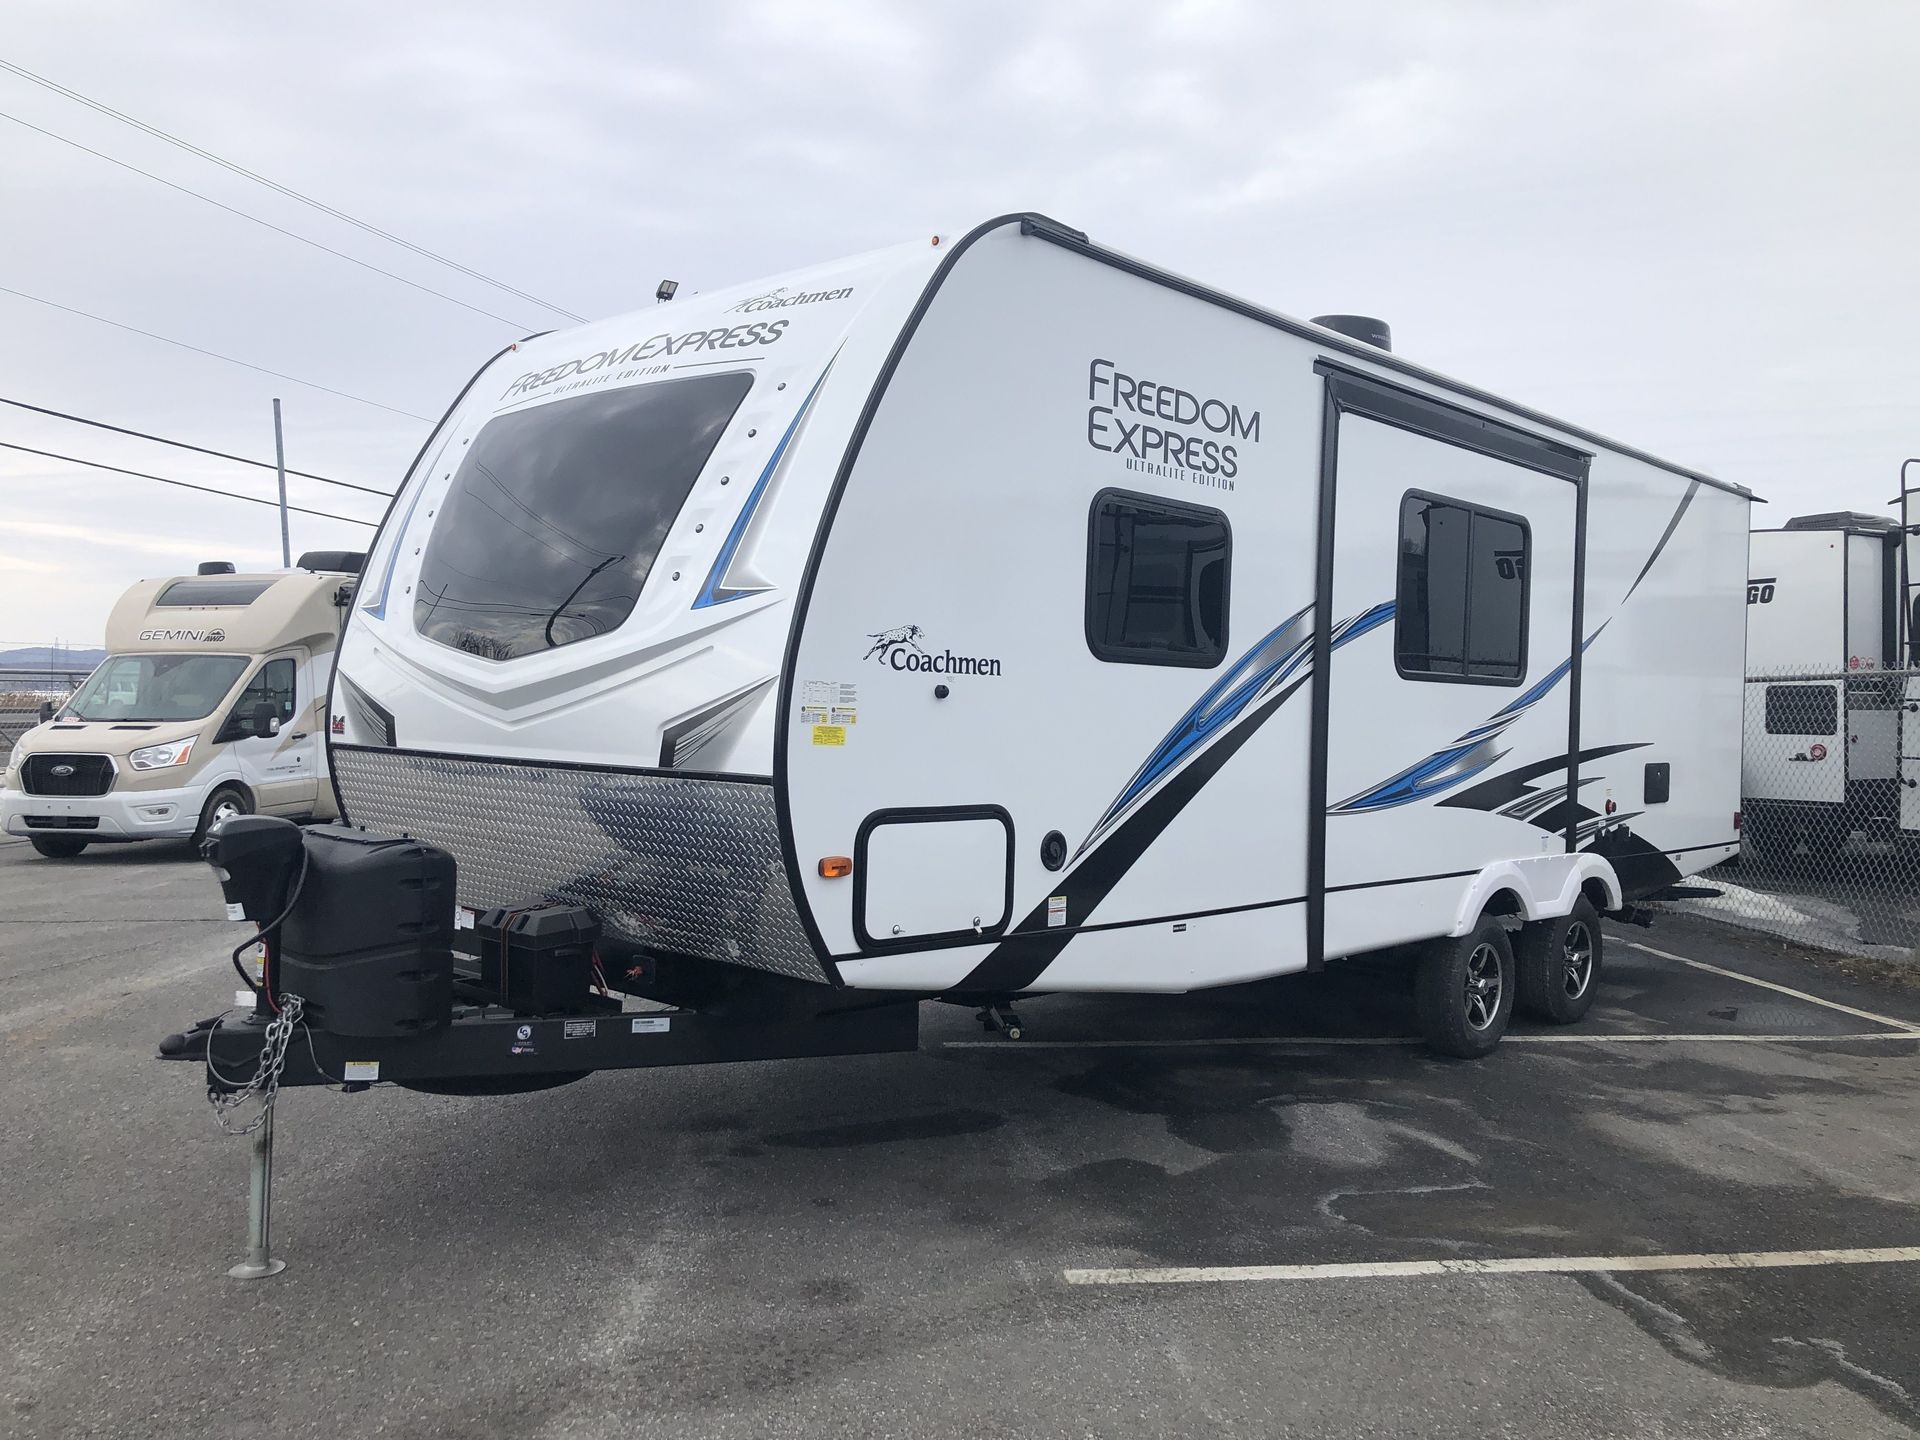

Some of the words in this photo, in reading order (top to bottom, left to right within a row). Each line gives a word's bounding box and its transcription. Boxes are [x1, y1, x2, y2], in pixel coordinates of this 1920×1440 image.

[744, 287, 854, 313] Coachmen
[499, 344, 640, 401] FREEDOM
[631, 319, 790, 362] EXPRESS
[553, 374, 612, 395] ULTRALITE
[617, 364, 671, 380] EDITION
[1089, 358, 1261, 443] FREEDOM
[1087, 405, 1238, 478] EXPRESS
[1126, 458, 1185, 482] ULTRALITE
[1192, 472, 1235, 491] EDITION
[139, 630, 205, 641] GEMINI
[890, 648, 1002, 676] Coachmen
